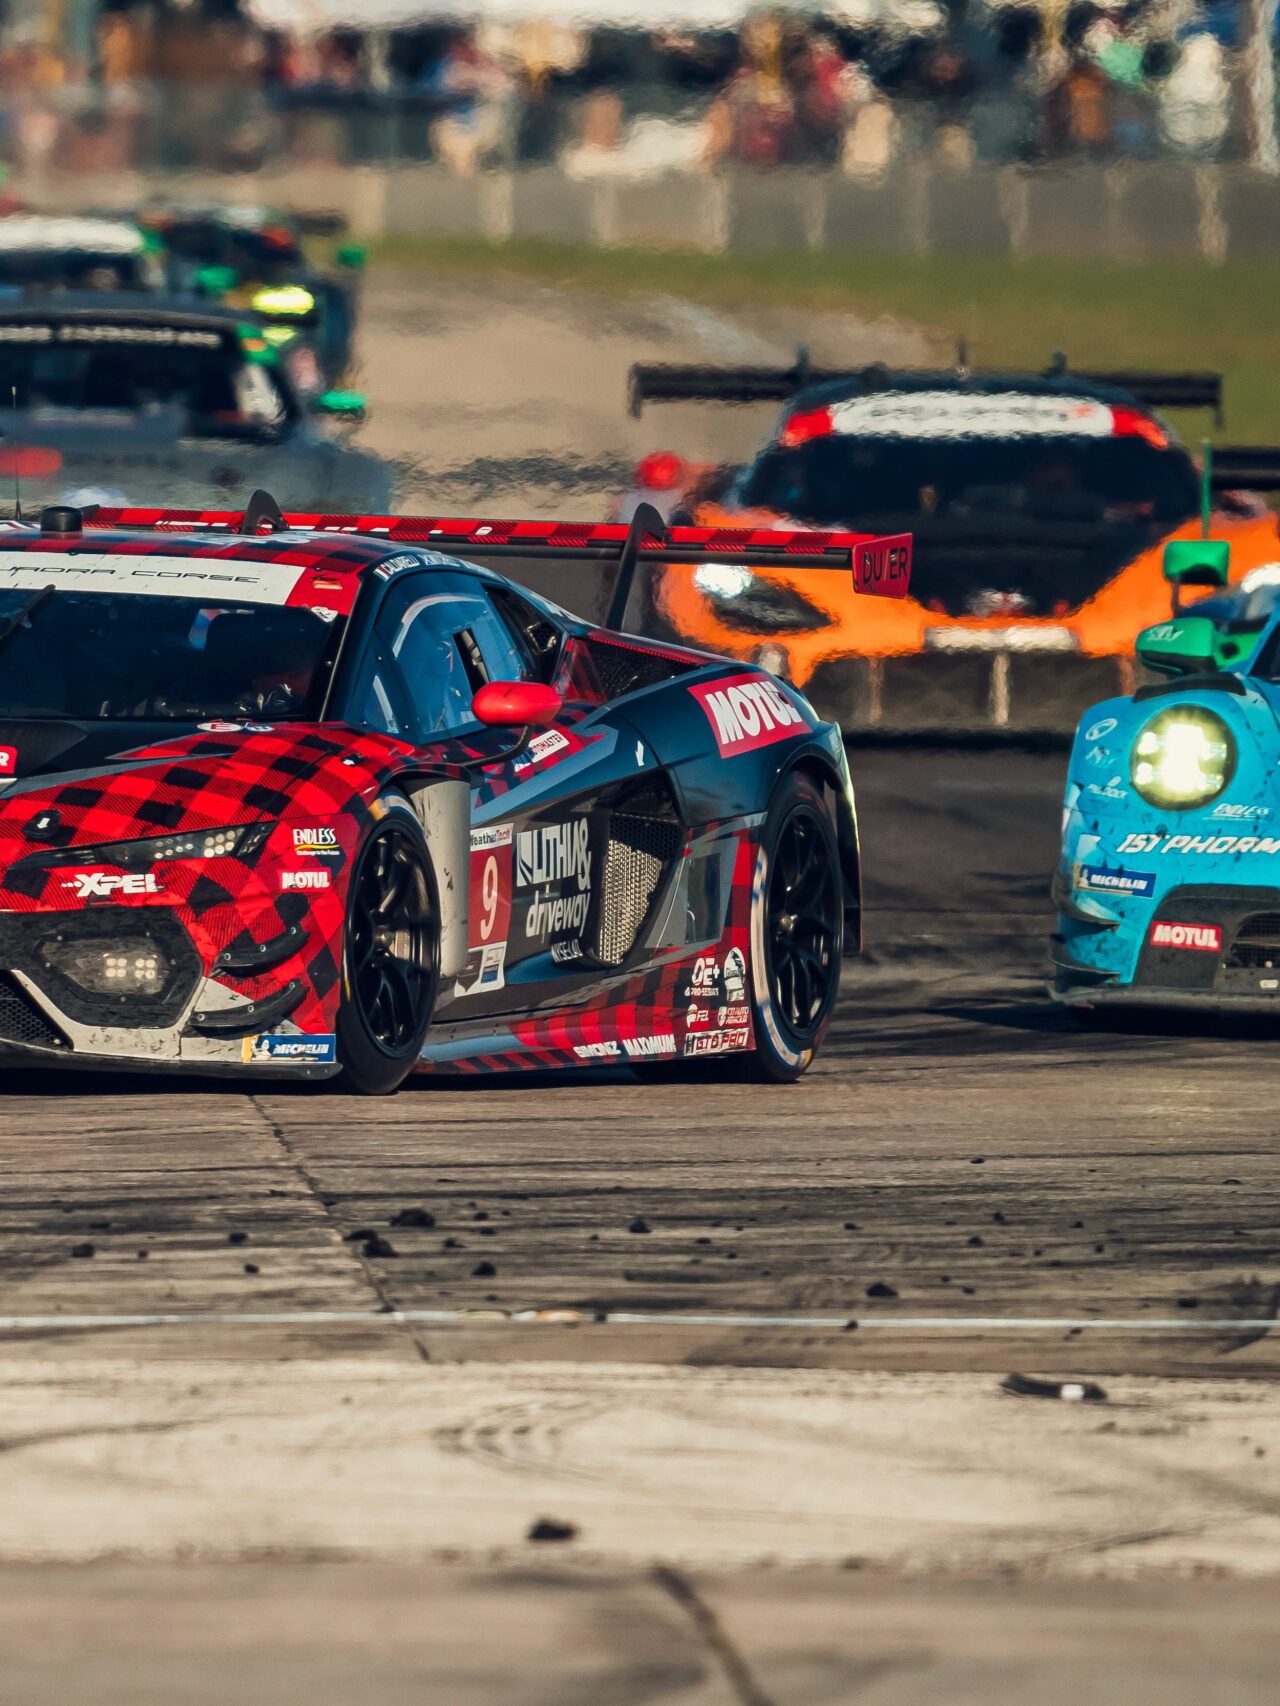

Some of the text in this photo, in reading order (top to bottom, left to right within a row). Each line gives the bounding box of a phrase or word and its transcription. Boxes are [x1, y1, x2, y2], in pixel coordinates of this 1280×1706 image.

[131, 570, 260, 583] CORSE
[704, 681, 803, 744] MOTUL
[293, 828, 336, 845] ENDLESS
[74, 873, 159, 897] XPEL
[281, 871, 330, 888] MOTUL
[1091, 875, 1148, 890] MICHELIN
[480, 855, 498, 940] 9
[526, 884, 590, 943] driveway
[1153, 925, 1218, 948] MOTUL
[273, 1043, 330, 1055] MICHELIN
